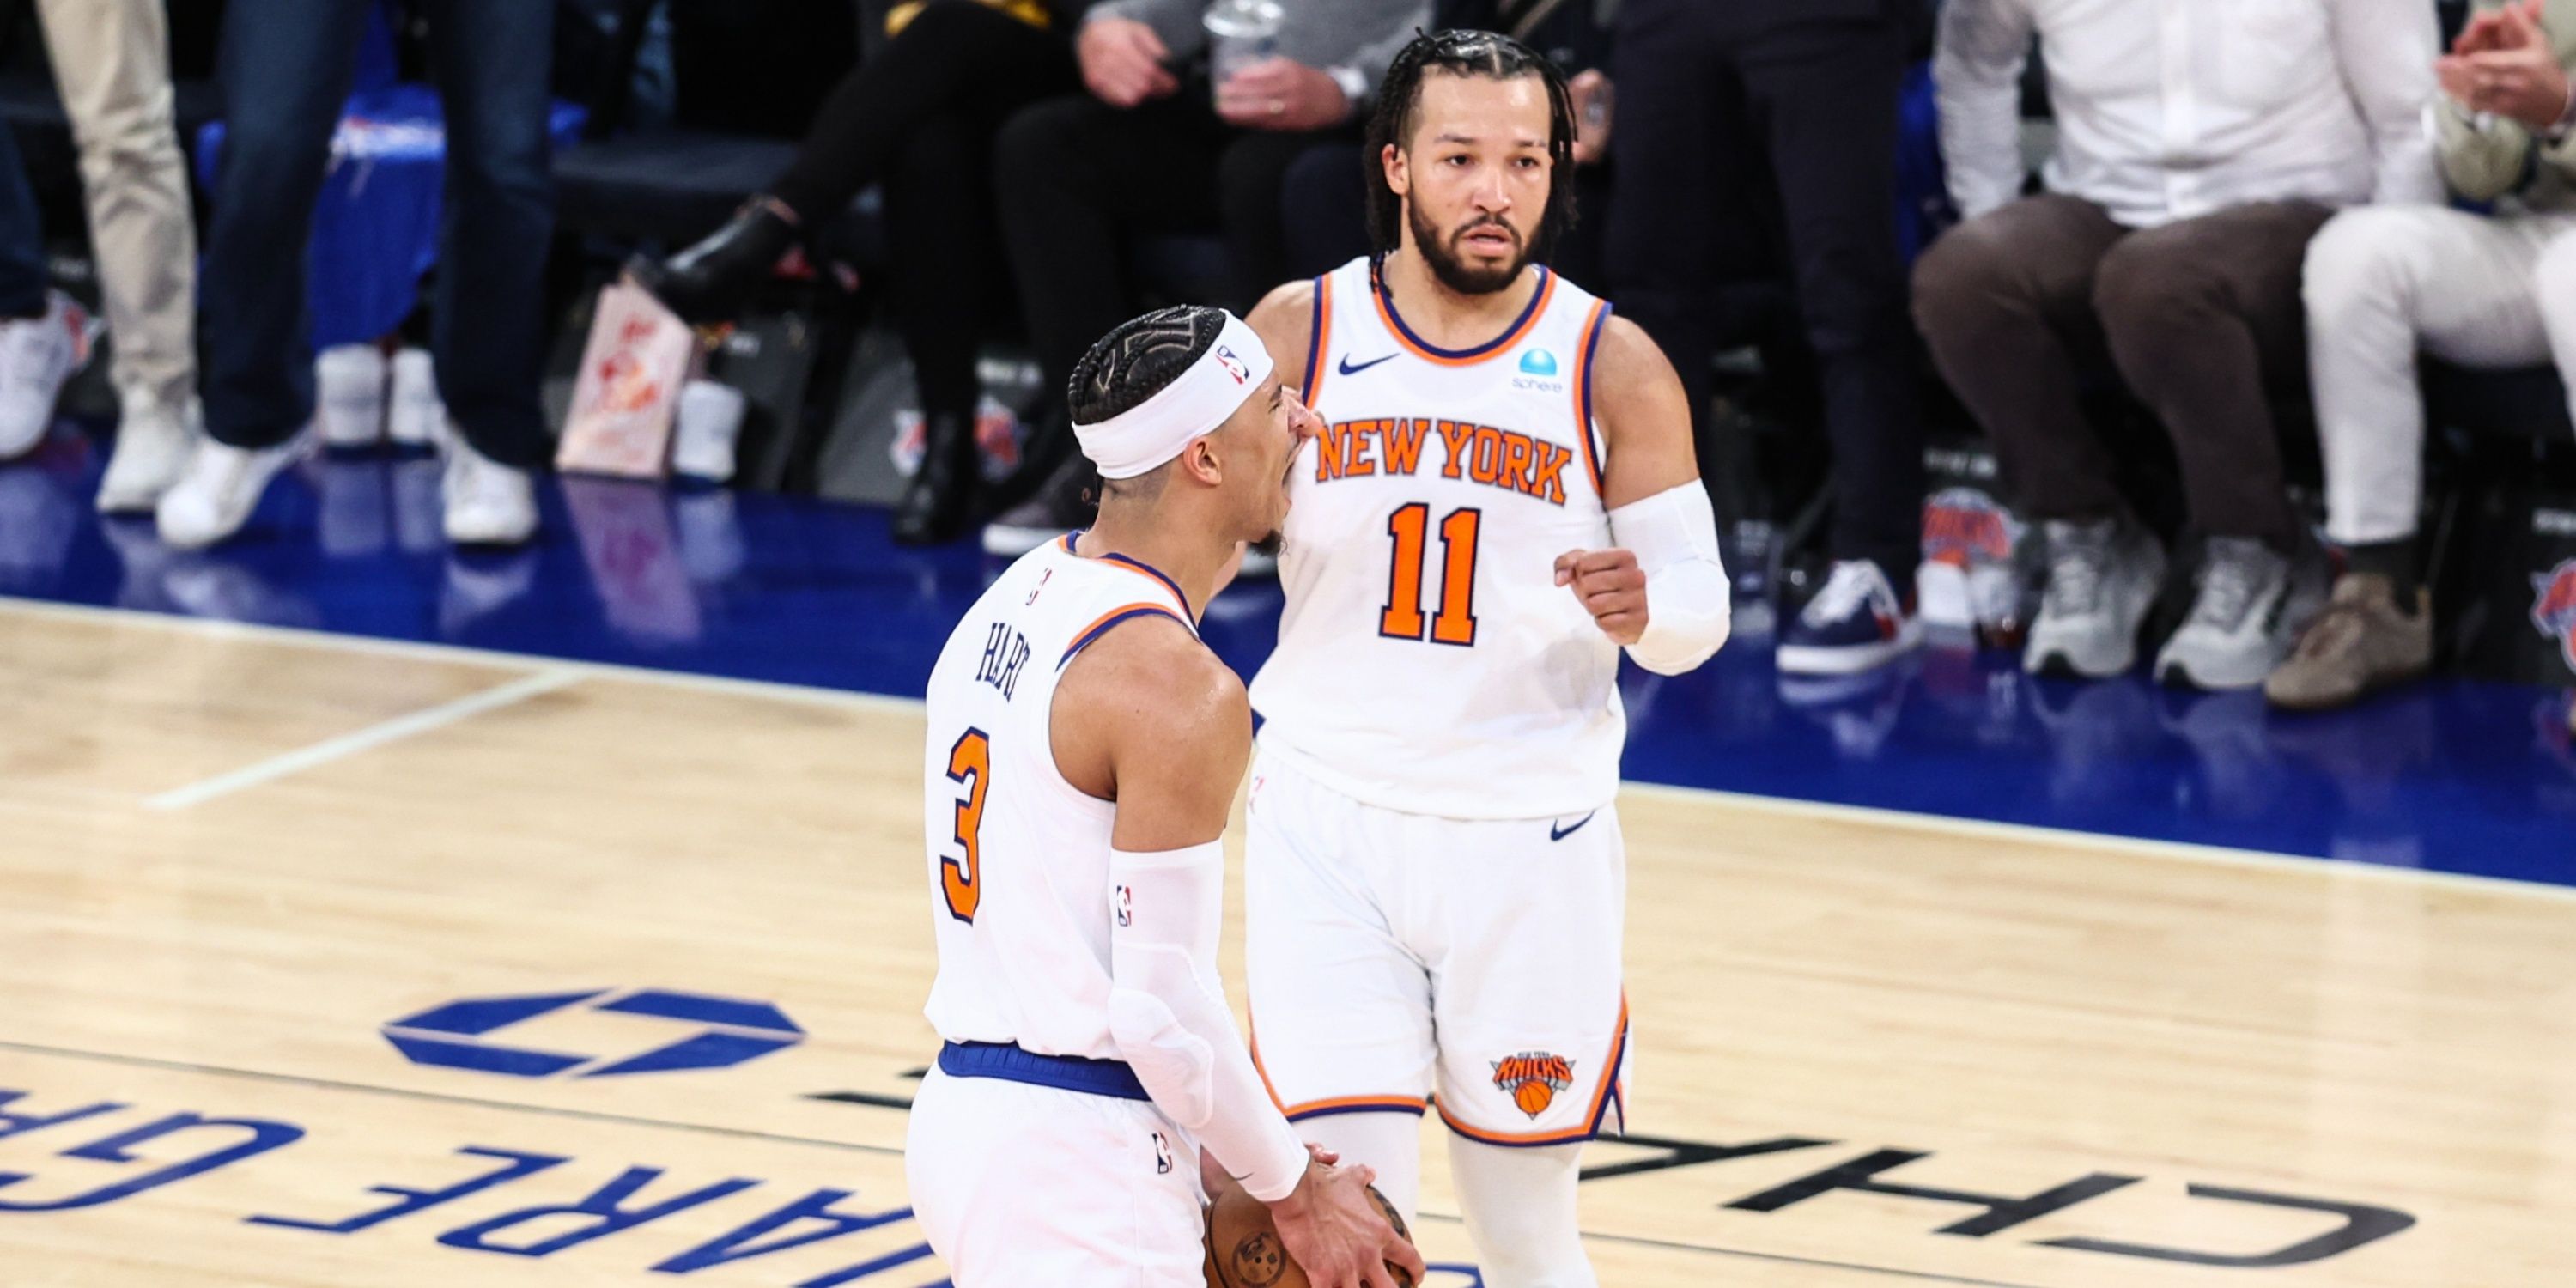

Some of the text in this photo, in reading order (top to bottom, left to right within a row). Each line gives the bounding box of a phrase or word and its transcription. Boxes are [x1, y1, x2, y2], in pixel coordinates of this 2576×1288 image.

[1511, 377, 1563, 394] sphere
[1315, 416, 1573, 508] NEW YORK
[1377, 501, 1482, 648] 11
[940, 725, 990, 927] 3
[1492, 1054, 1573, 1084] KNICKS
